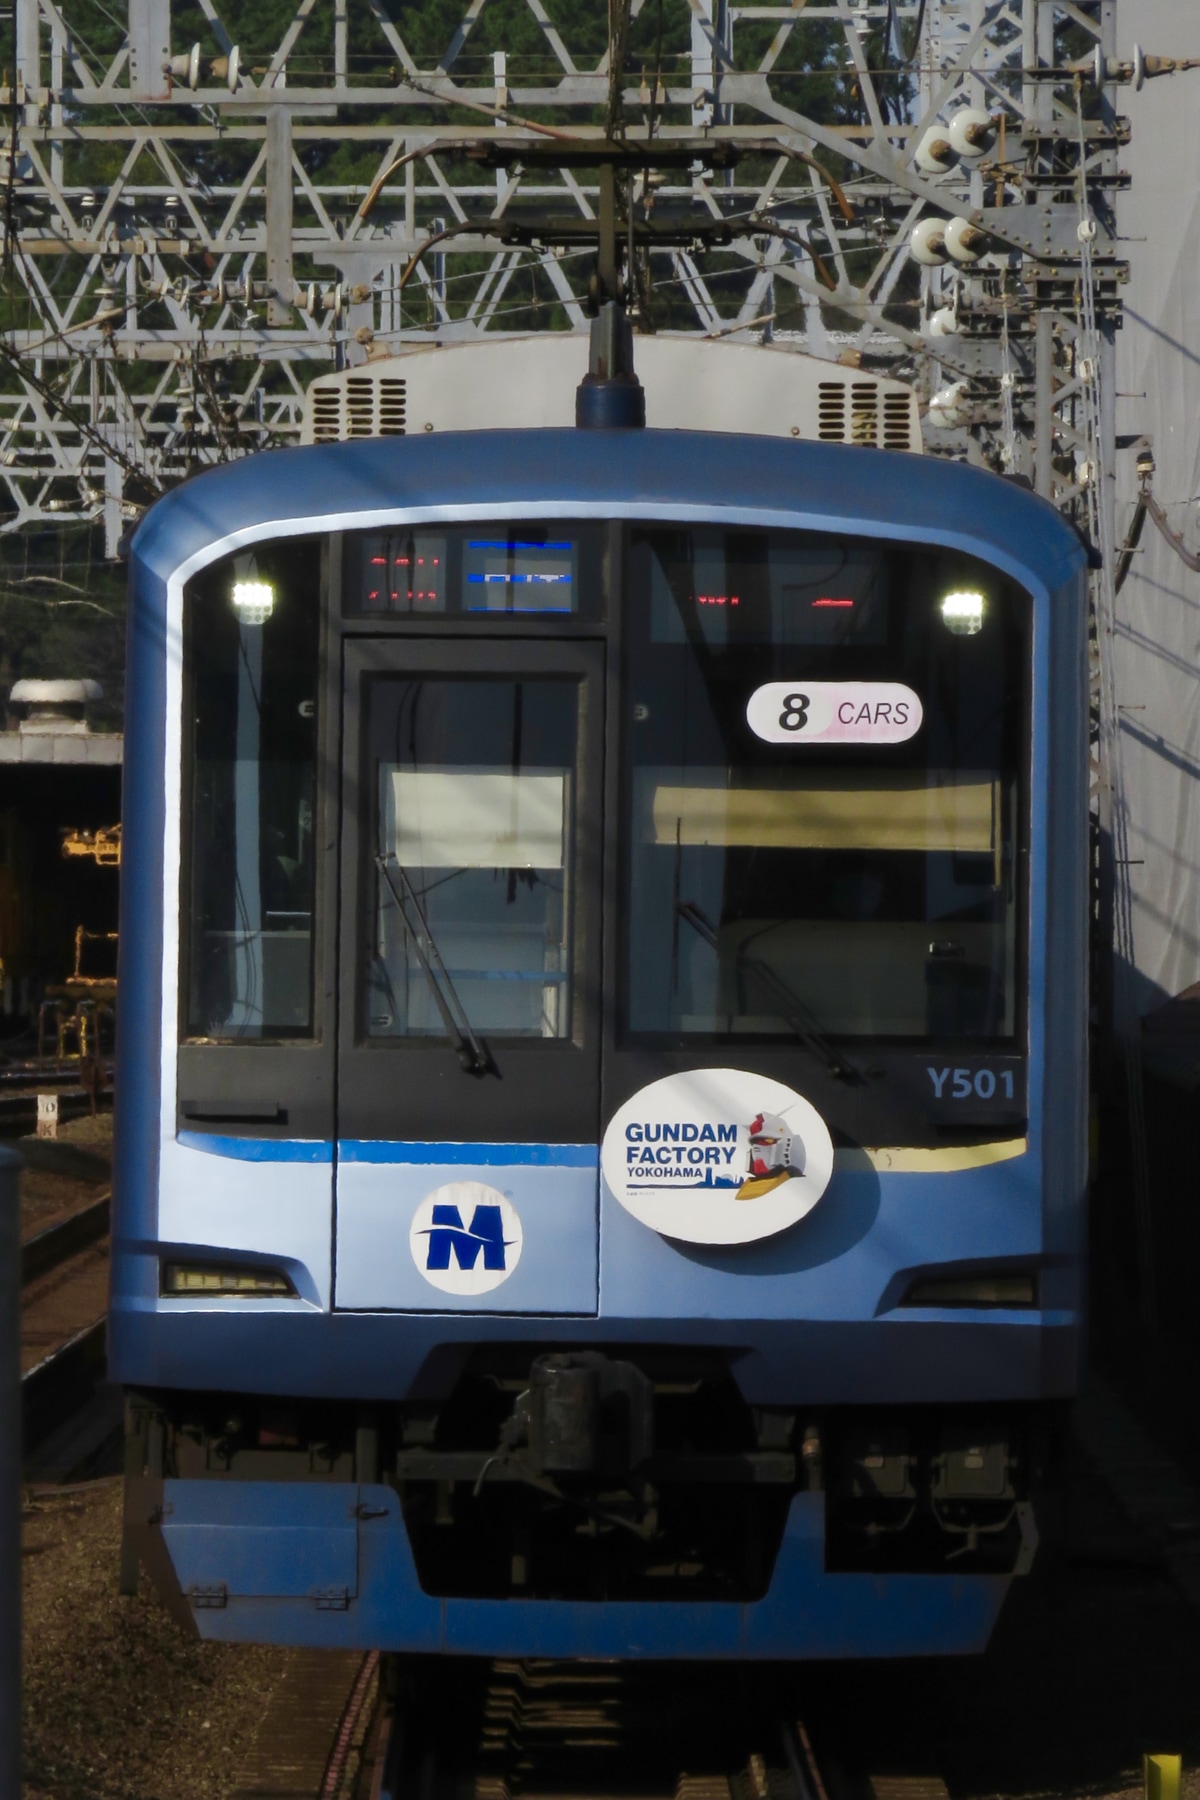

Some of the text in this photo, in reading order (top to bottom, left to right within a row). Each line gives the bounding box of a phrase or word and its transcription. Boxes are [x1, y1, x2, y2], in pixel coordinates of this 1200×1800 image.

[778, 693, 910, 731] 8 CARS
[926, 1067, 1014, 1099] Y501
[625, 1122, 738, 1143] GUNDAM
[626, 1146, 737, 1165] FACTORY
[627, 1166, 704, 1178] YOKOHAMA
